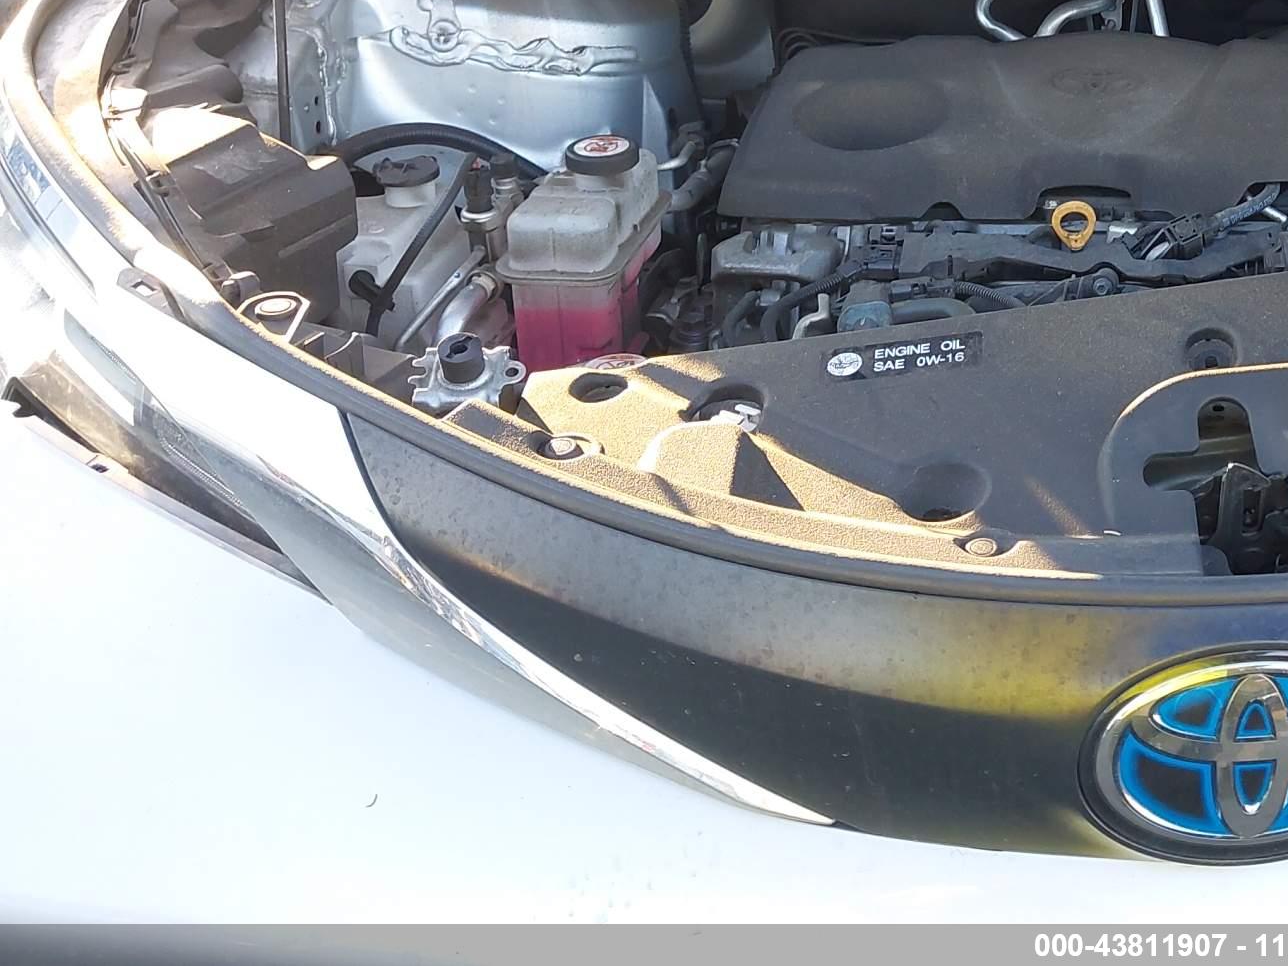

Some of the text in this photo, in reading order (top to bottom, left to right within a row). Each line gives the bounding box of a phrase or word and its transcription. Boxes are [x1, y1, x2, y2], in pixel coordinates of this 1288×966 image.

[874, 339, 966, 359] ENGINE OIL
[873, 352, 965, 372] SAE 0W-16
